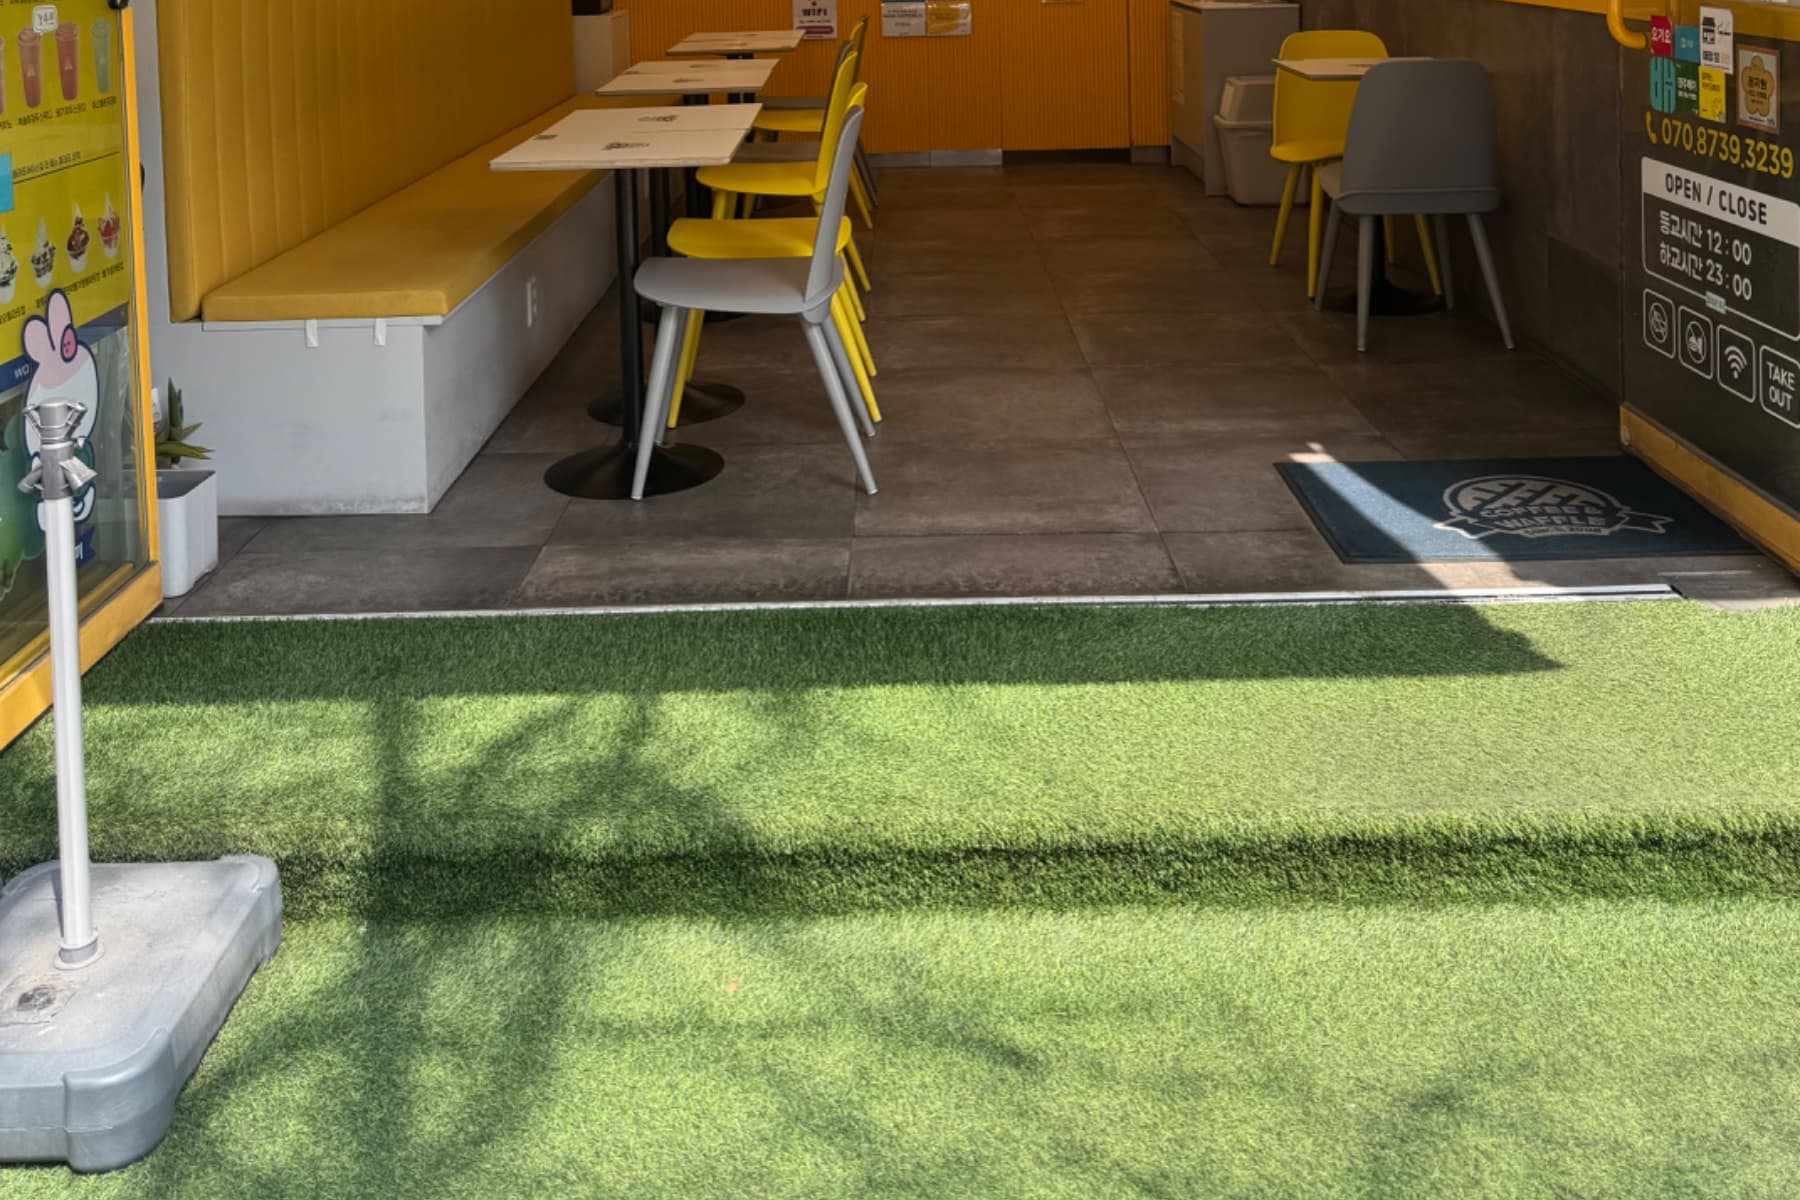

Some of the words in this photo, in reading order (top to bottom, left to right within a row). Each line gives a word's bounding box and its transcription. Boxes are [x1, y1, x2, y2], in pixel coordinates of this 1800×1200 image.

[1661, 118, 1795, 179] 070.8739.3239
[1664, 172, 1702, 204] OPEN
[1718, 189, 1768, 225] CLOSE
[1659, 210, 1703, 248] 등교시간
[1659, 242, 1703, 281] 하교시간
[1765, 360, 1796, 392] TAKE
[1768, 385, 1794, 412] OUT
